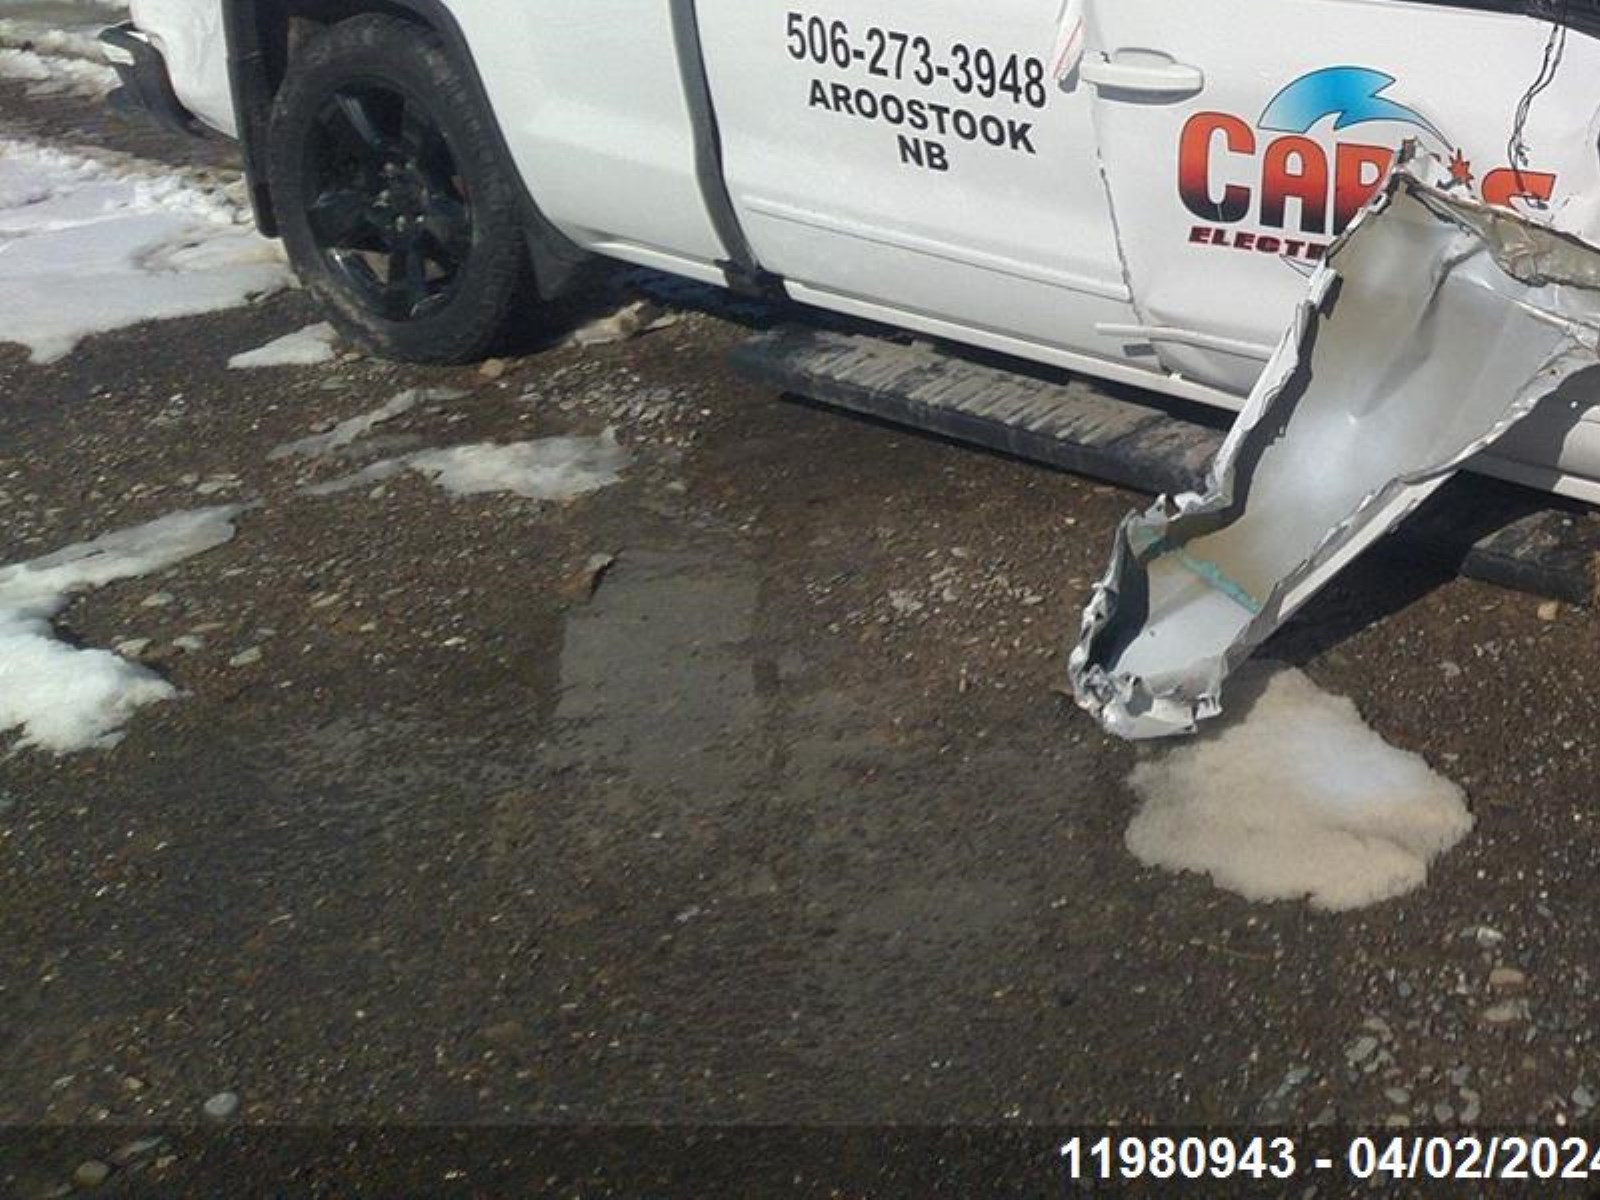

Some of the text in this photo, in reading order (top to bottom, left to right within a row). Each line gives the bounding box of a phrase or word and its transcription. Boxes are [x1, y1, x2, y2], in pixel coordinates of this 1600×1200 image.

[786, 12, 1047, 108] 506-273-3948
[808, 79, 1036, 154] AROOSTOOK
[896, 134, 950, 171] NB
